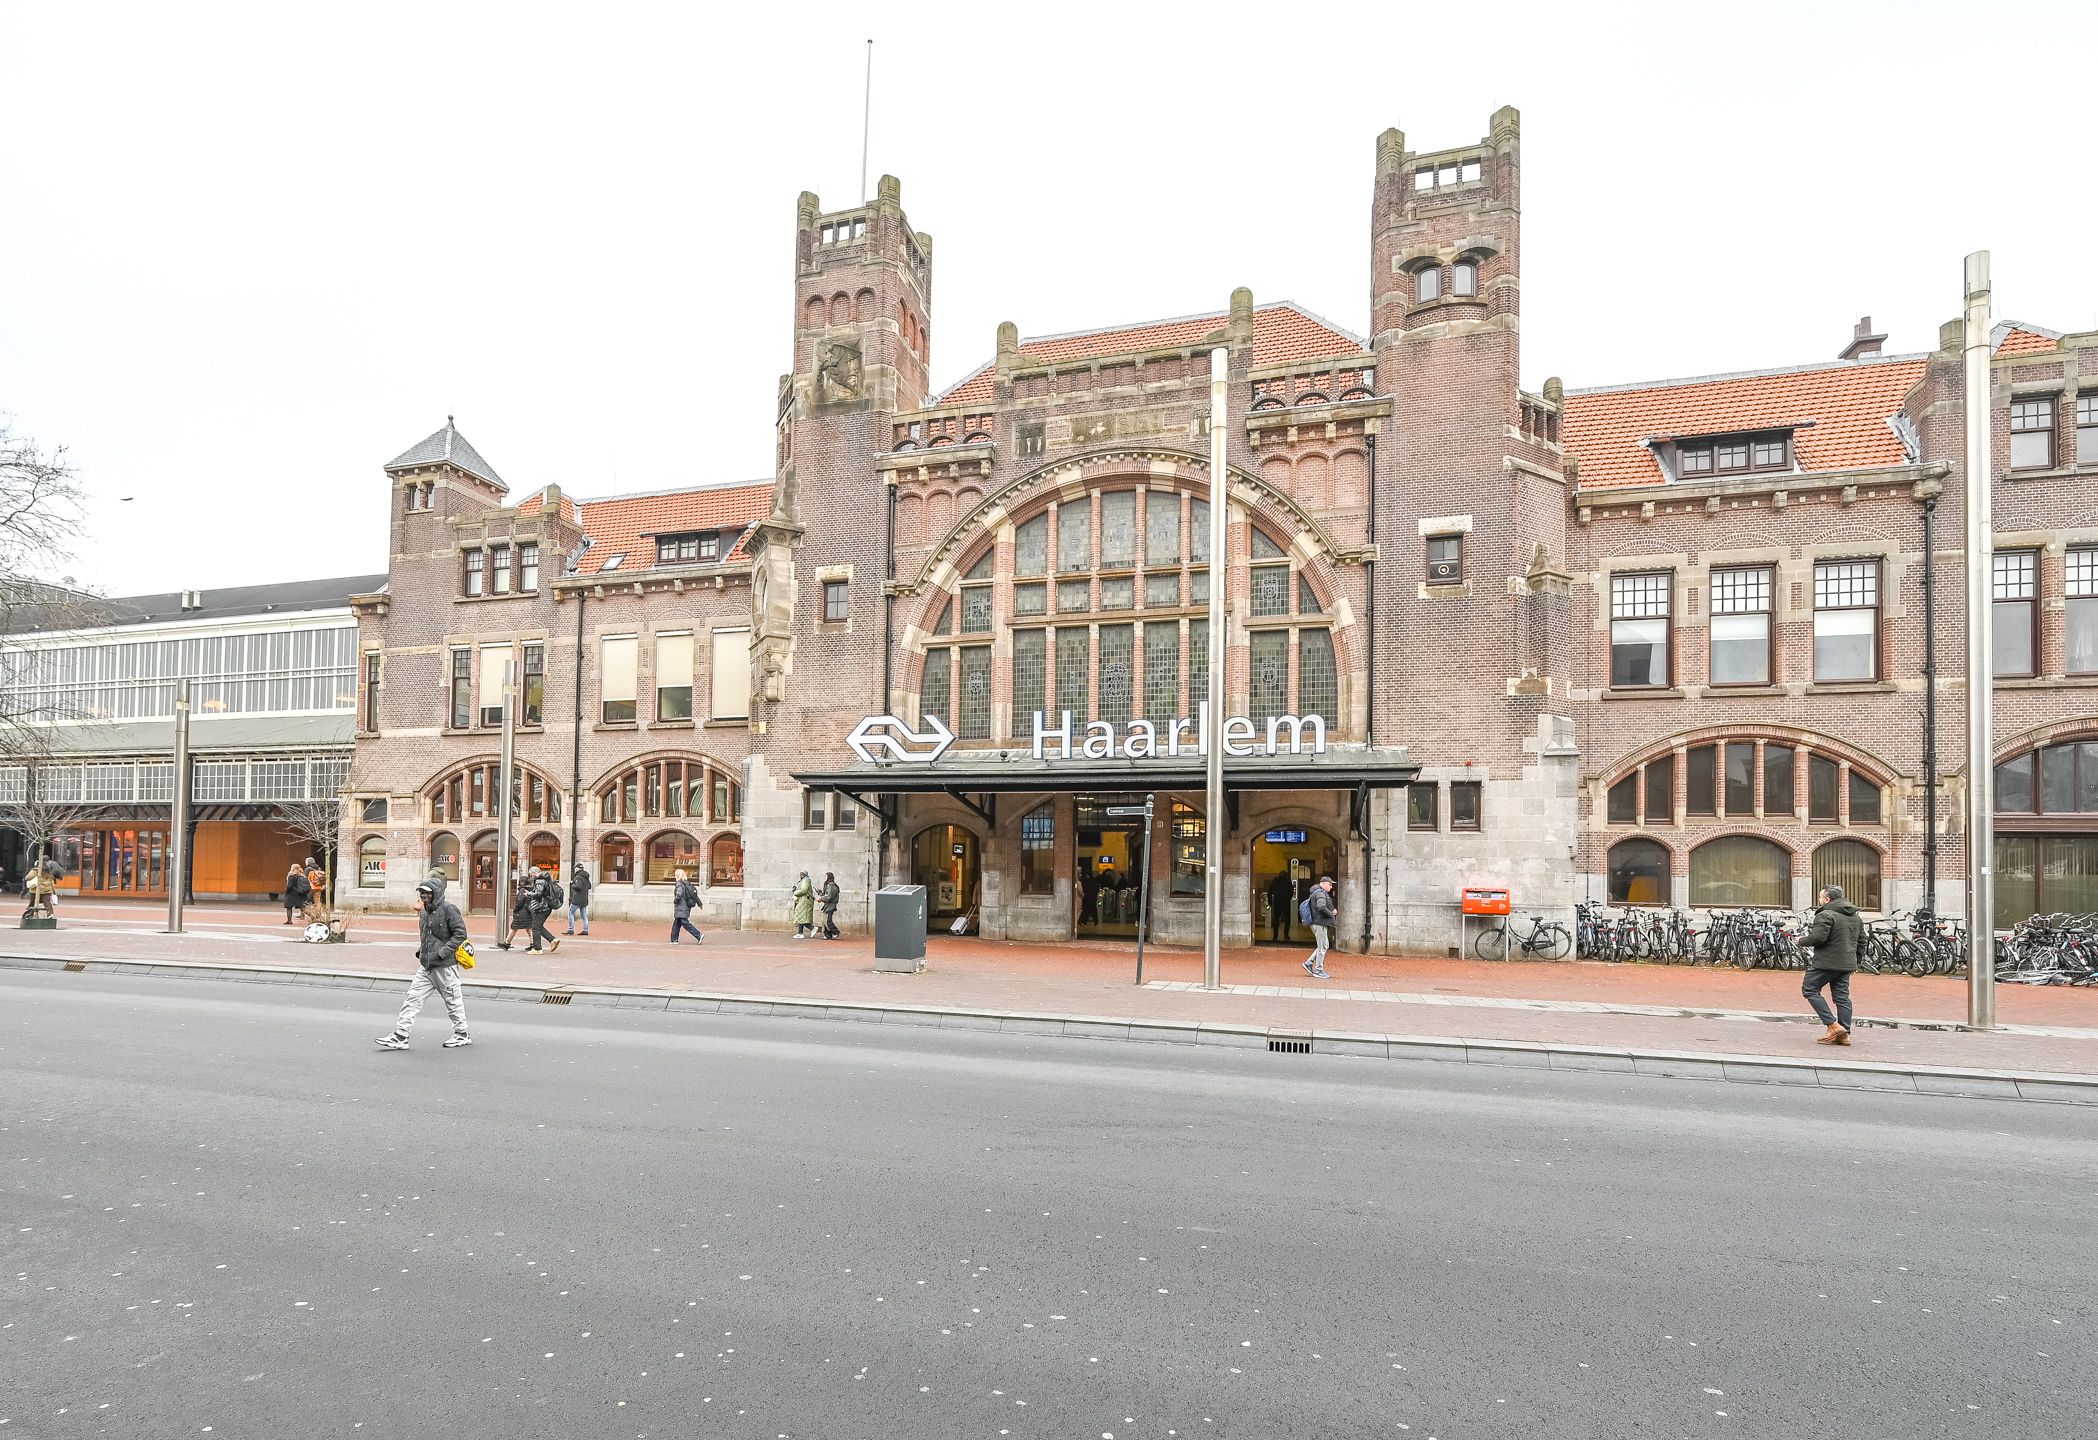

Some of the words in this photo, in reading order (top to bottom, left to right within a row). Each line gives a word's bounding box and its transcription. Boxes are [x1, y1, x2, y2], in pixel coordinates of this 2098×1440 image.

[1033, 701, 1326, 760] Haarlem
[438, 854, 455, 863] AKO
[365, 861, 386, 871] AKO
